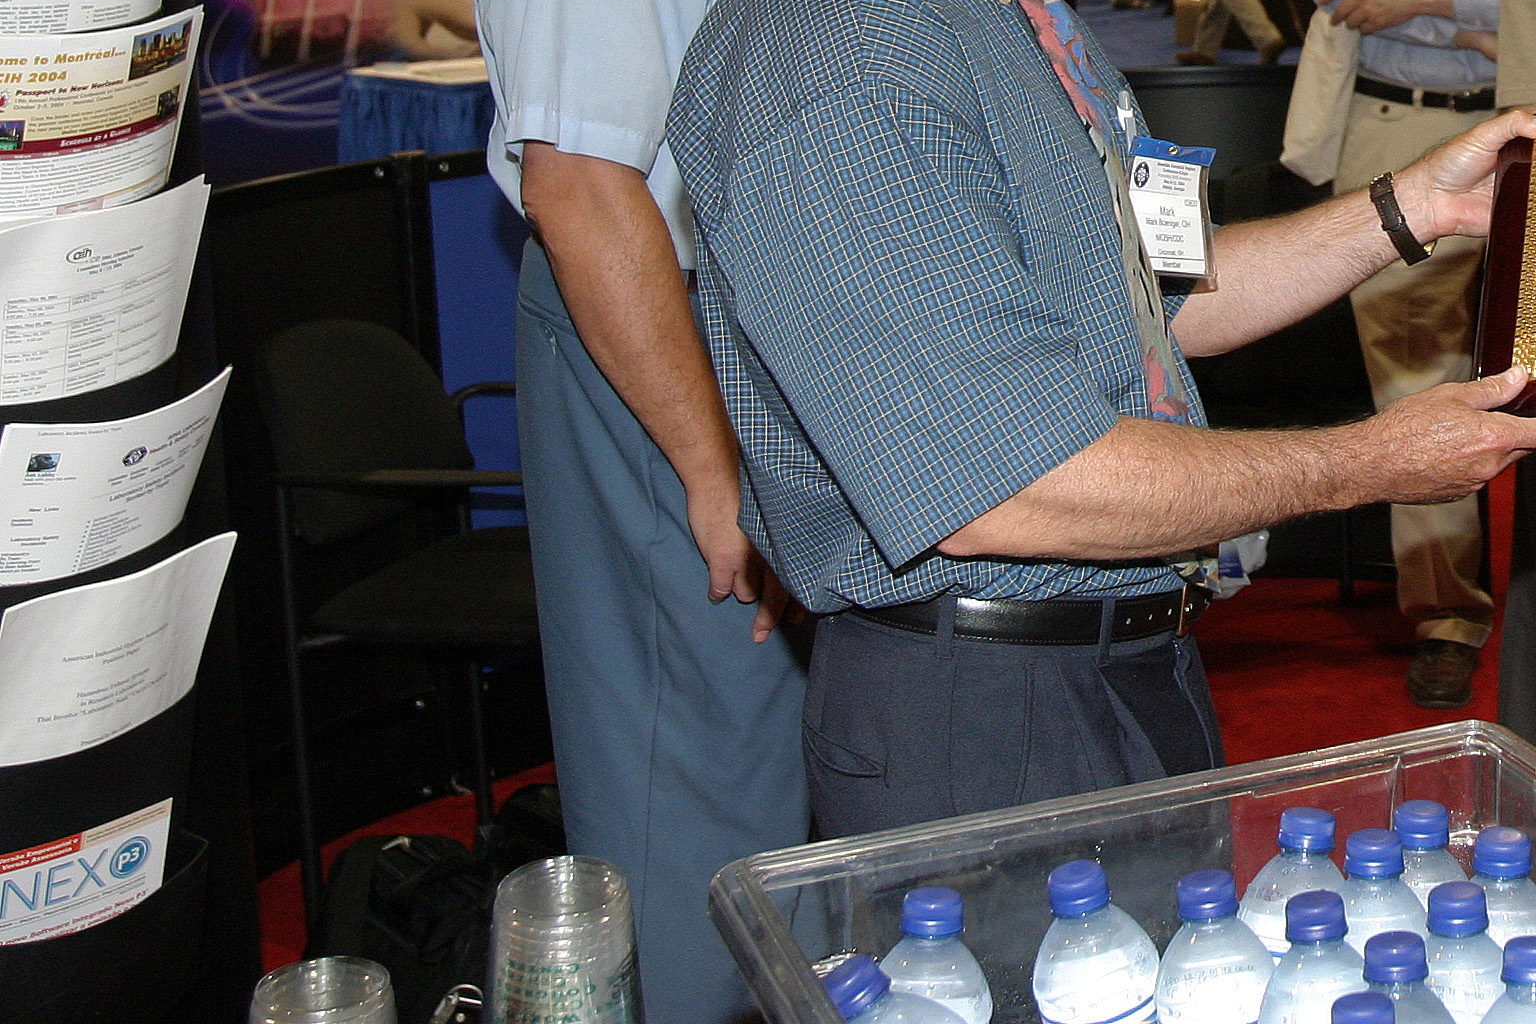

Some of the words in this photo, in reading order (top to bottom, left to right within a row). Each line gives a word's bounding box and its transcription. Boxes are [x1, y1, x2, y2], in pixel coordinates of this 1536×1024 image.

[33, 55, 48, 66] to
[27, 71, 67, 82] 2004
[1159, 206, 1176, 217] Mark
[117, 846, 141, 871] P3
